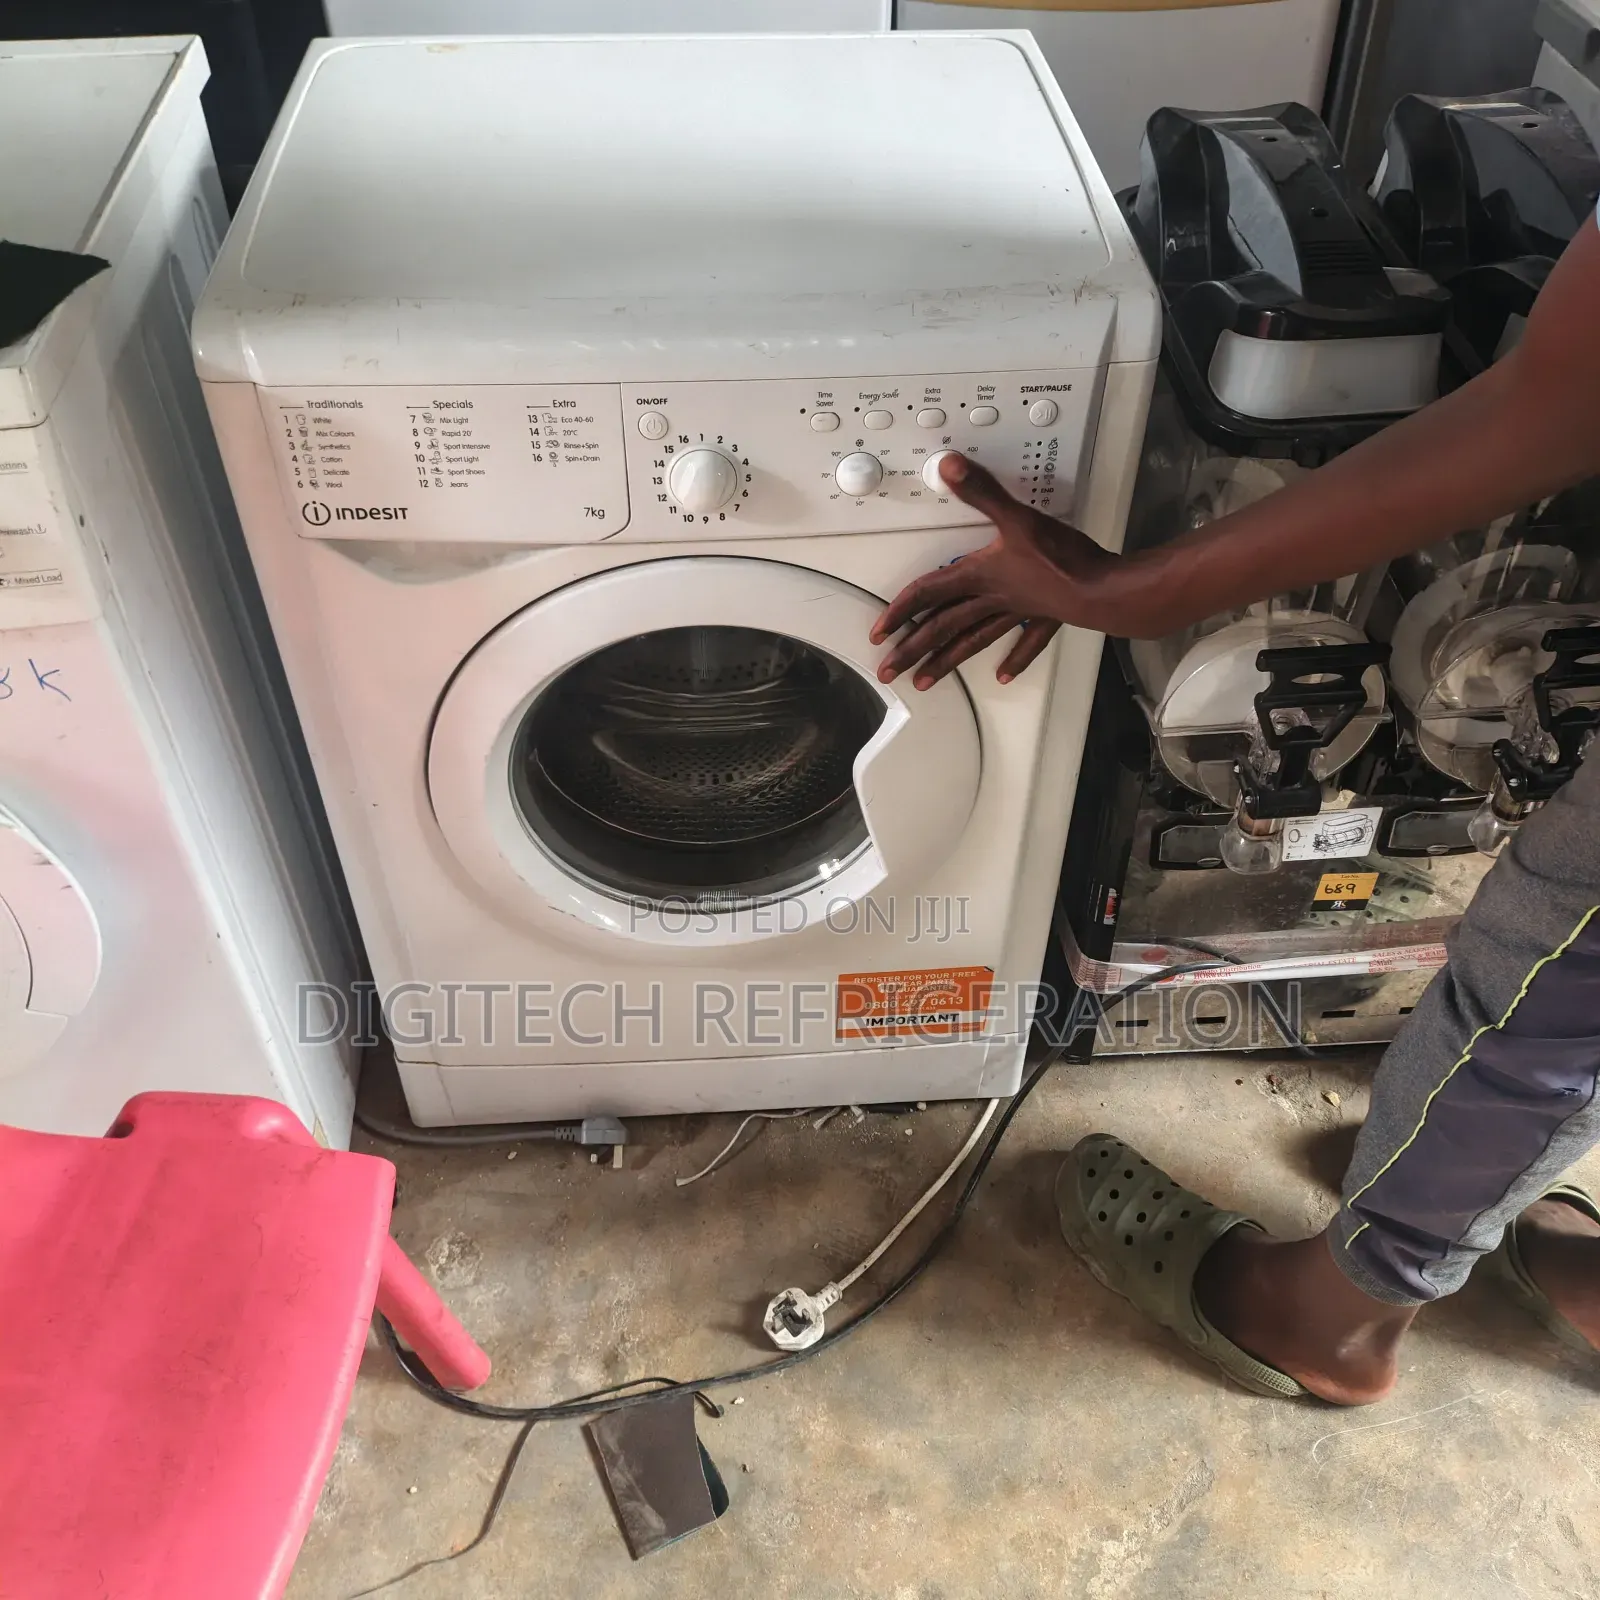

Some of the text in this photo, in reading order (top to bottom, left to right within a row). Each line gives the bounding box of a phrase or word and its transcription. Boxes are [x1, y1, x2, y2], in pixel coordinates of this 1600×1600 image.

[977, 385, 996, 393] Delay
[1020, 384, 1072, 394] START/PAUSE
[859, 391, 899, 401] Energy Saver
[306, 400, 364, 409] Traditionals
[432, 399, 474, 410] Specials
[552, 399, 577, 408] Extra
[284, 415, 289, 424] 1
[410, 415, 416, 424] 7
[453, 417, 469, 425] Light
[527, 414, 538, 424] 13
[561, 416, 573, 424] Eco
[286, 428, 294, 438] 2
[412, 428, 419, 437] 8
[442, 430, 461, 438] Rapid
[529, 427, 540, 436] 14
[678, 435, 689, 444] 16
[699, 433, 704, 442] 1
[717, 436, 723, 444] 2
[289, 441, 296, 451] 3
[414, 441, 421, 450] 9
[443, 443, 461, 451] Sport
[531, 440, 599, 450] 15 Rinse+Spin
[664, 445, 674, 454] 15
[732, 444, 738, 452] 3
[292, 455, 298, 463] 4
[414, 454, 425, 463] 10
[464, 456, 479, 464] Light
[532, 453, 601, 463] 16 Spin+Drain
[742, 458, 749, 466] 4
[653, 460, 665, 468] 14
[294, 467, 301, 476] 5
[417, 466, 426, 476] 11
[447, 468, 465, 476] Sport
[652, 477, 663, 485] 13
[745, 474, 752, 482] 5
[297, 480, 304, 488] 6
[419, 479, 429, 488] 12
[657, 494, 667, 502] 12
[669, 506, 677, 514] 11
[734, 504, 740, 512] 7
[583, 507, 606, 520] 7kg
[719, 513, 726, 521] 8
[683, 515, 694, 523] 10
[703, 516, 709, 524] 9
[41, 572, 63, 583] Load
[1325, 883, 1356, 894] 689
[854, 976, 902, 984] REGISTER
[924, 972, 949, 980] YOUR
[926, 978, 955, 986] PARTS
[864, 1000, 898, 1010] 0800
[930, 996, 964, 1006] 0613
[866, 1013, 960, 1027] IMPORTANT
